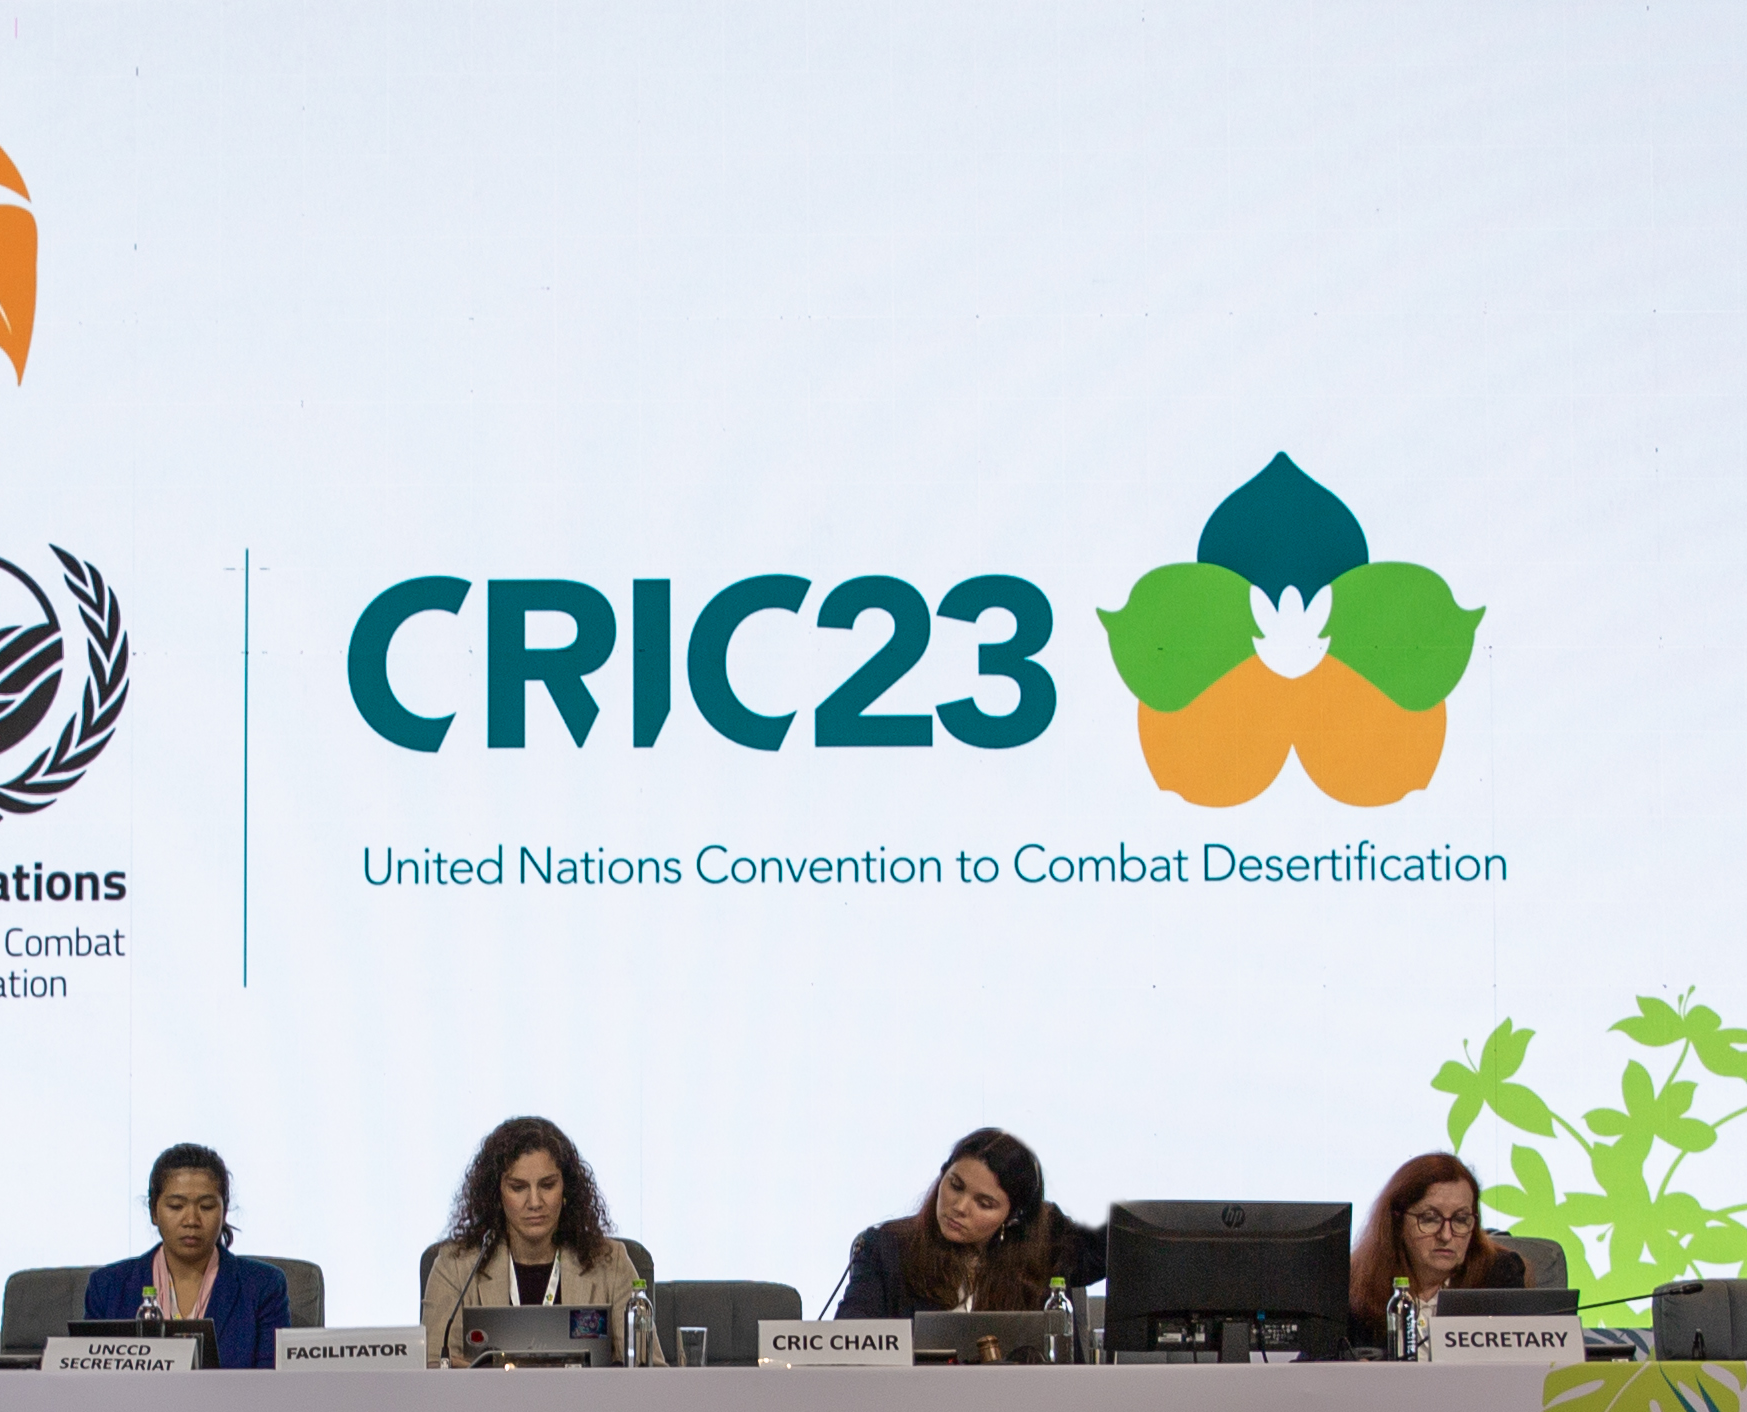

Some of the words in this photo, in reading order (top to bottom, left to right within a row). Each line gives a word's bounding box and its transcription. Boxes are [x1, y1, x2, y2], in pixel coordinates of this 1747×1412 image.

[347, 573, 1057, 753] CRIC23
[364, 844, 503, 885] United
[520, 846, 682, 884] Nations
[696, 845, 941, 884] Convention
[956, 851, 999, 883] to
[1014, 842, 1188, 883] Combat
[1204, 840, 1507, 882] Desertification
[5, 927, 125, 957] Combat
[773, 1335, 822, 1350] CRIC
[830, 1335, 899, 1350] CHAIR
[1445, 1332, 1567, 1347] SECRETARY
[89, 1344, 151, 1355] UNCCD
[287, 1344, 407, 1359] FACILITATOR
[60, 1358, 174, 1370] SECRETARIAT
